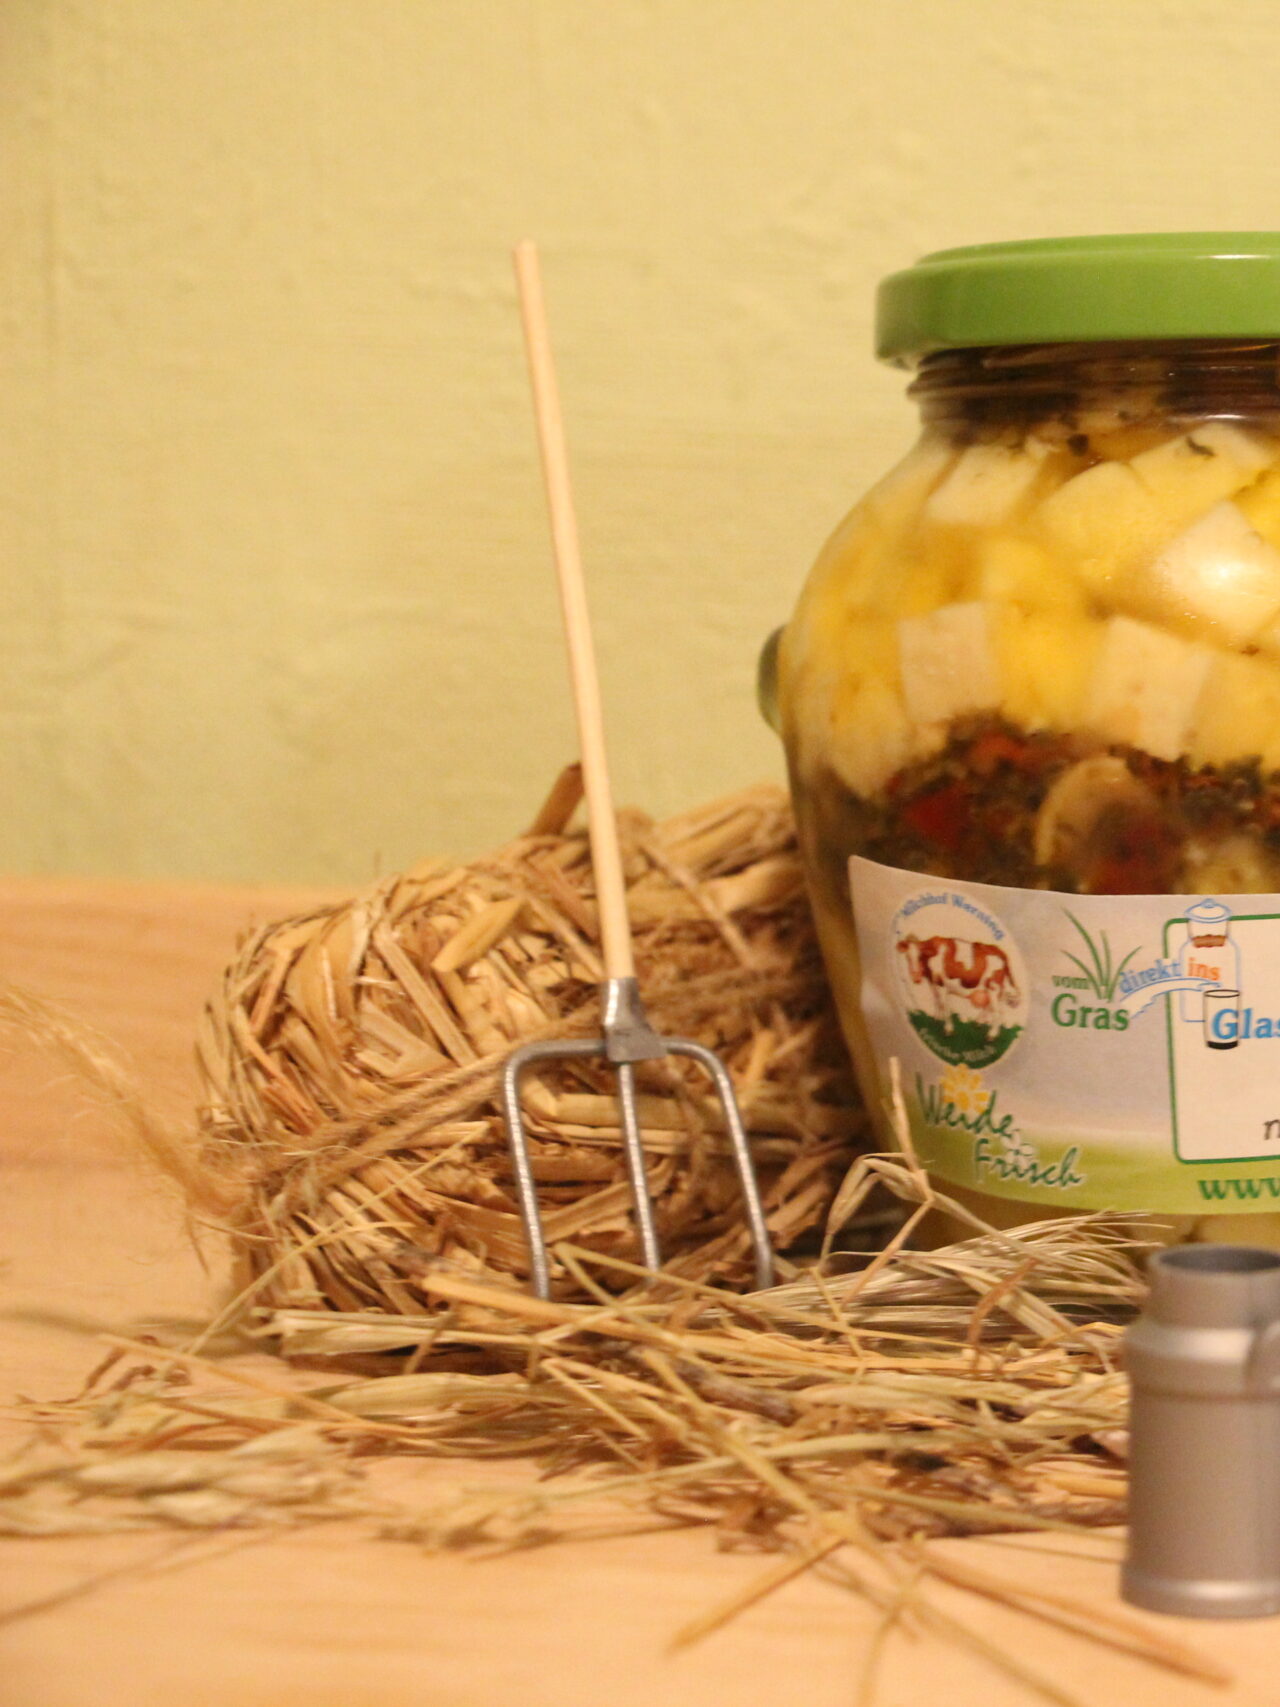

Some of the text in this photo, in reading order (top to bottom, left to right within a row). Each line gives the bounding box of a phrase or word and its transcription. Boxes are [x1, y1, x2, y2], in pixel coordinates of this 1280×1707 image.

[1051, 973, 1092, 991] vom
[1119, 956, 1221, 993] direkt ins
[1052, 993, 1130, 1032] Gras
